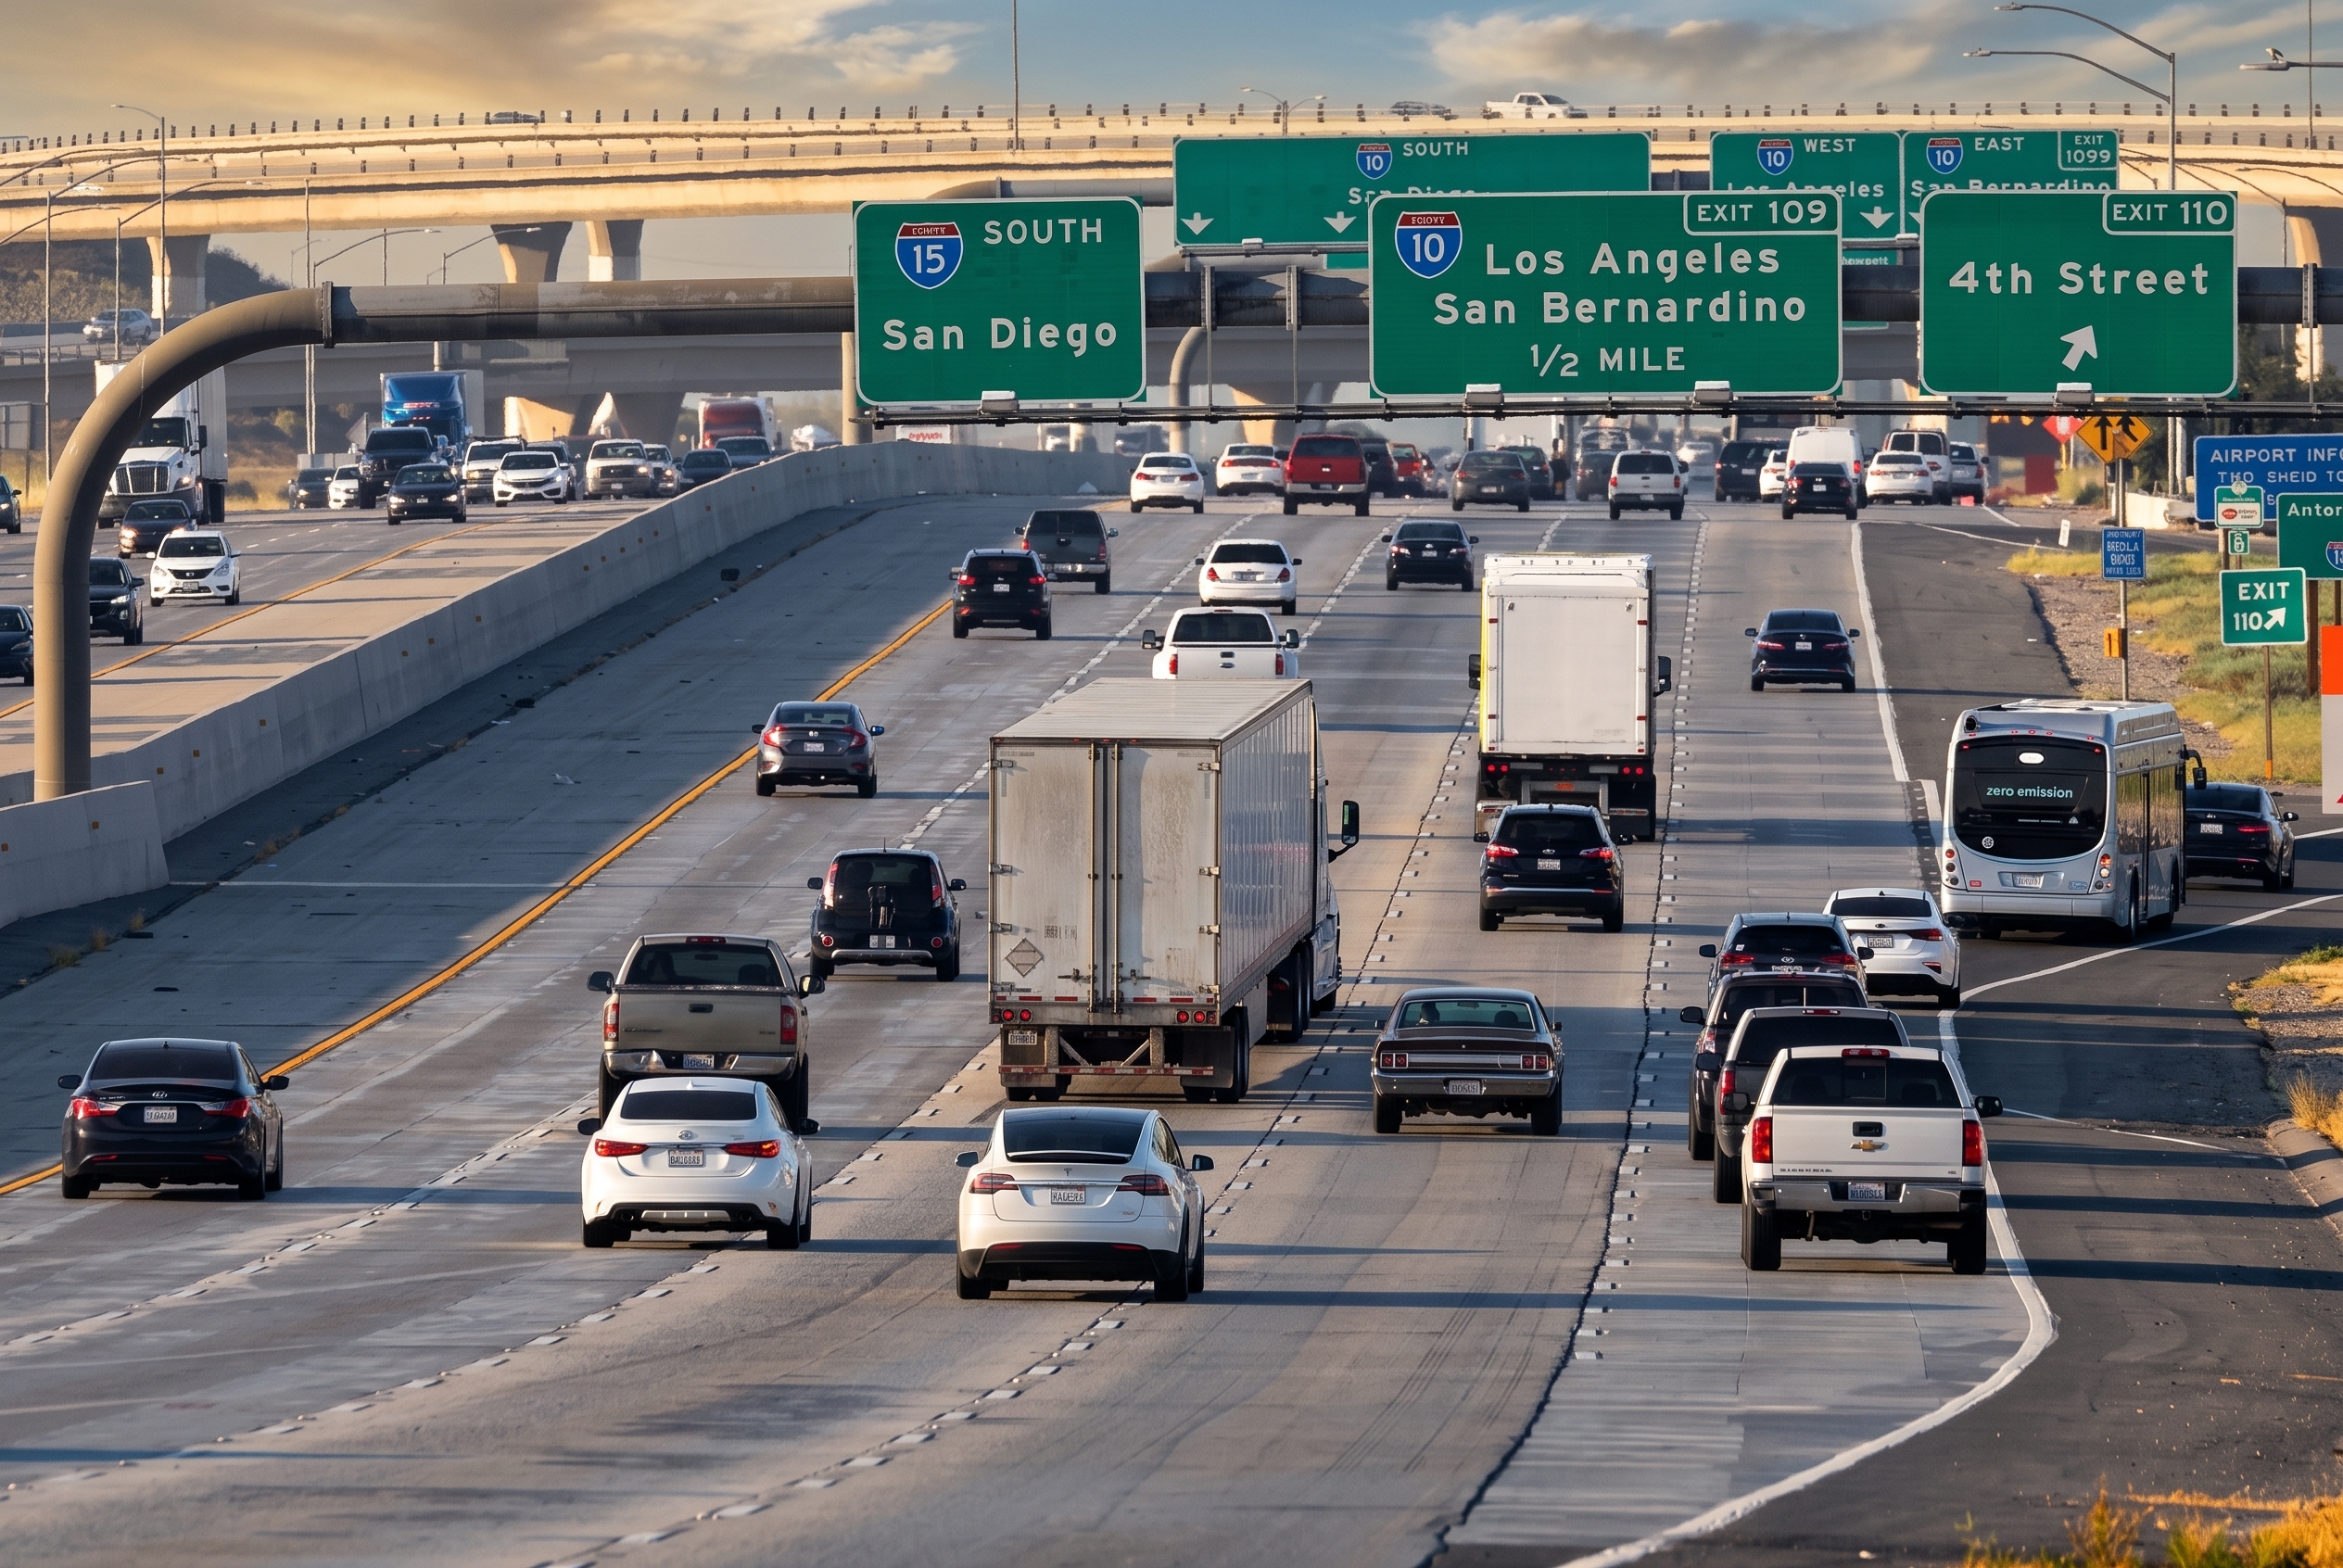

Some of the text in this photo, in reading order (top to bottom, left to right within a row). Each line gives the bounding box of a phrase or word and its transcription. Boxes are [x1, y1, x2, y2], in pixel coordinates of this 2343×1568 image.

[1767, 138, 1856, 167] 10 WEST
[1935, 136, 2025, 166] 10 EAST
[2074, 134, 2104, 145] EXIT
[1365, 141, 1468, 171] 10 SOUTH
[2066, 149, 2111, 164] 1099
[1697, 199, 1827, 224] EXIT 109
[2113, 200, 2228, 225] EXIT 110
[913, 218, 1102, 274] 15 SOUTH
[1412, 233, 1445, 263] 10
[1486, 241, 1779, 284] Los Angeles
[1949, 261, 2209, 295] 4th Street
[1433, 289, 1805, 325] San Bernardino
[882, 316, 1117, 358] San Diego
[1530, 343, 1685, 377] 1/2 MILE
[2210, 448, 2297, 463] AIRPORT
[2267, 471, 2317, 483] SHEID
[2238, 581, 2290, 601] EXIT
[2233, 612, 2263, 631] 110
[1986, 786, 2073, 799] zero emission
